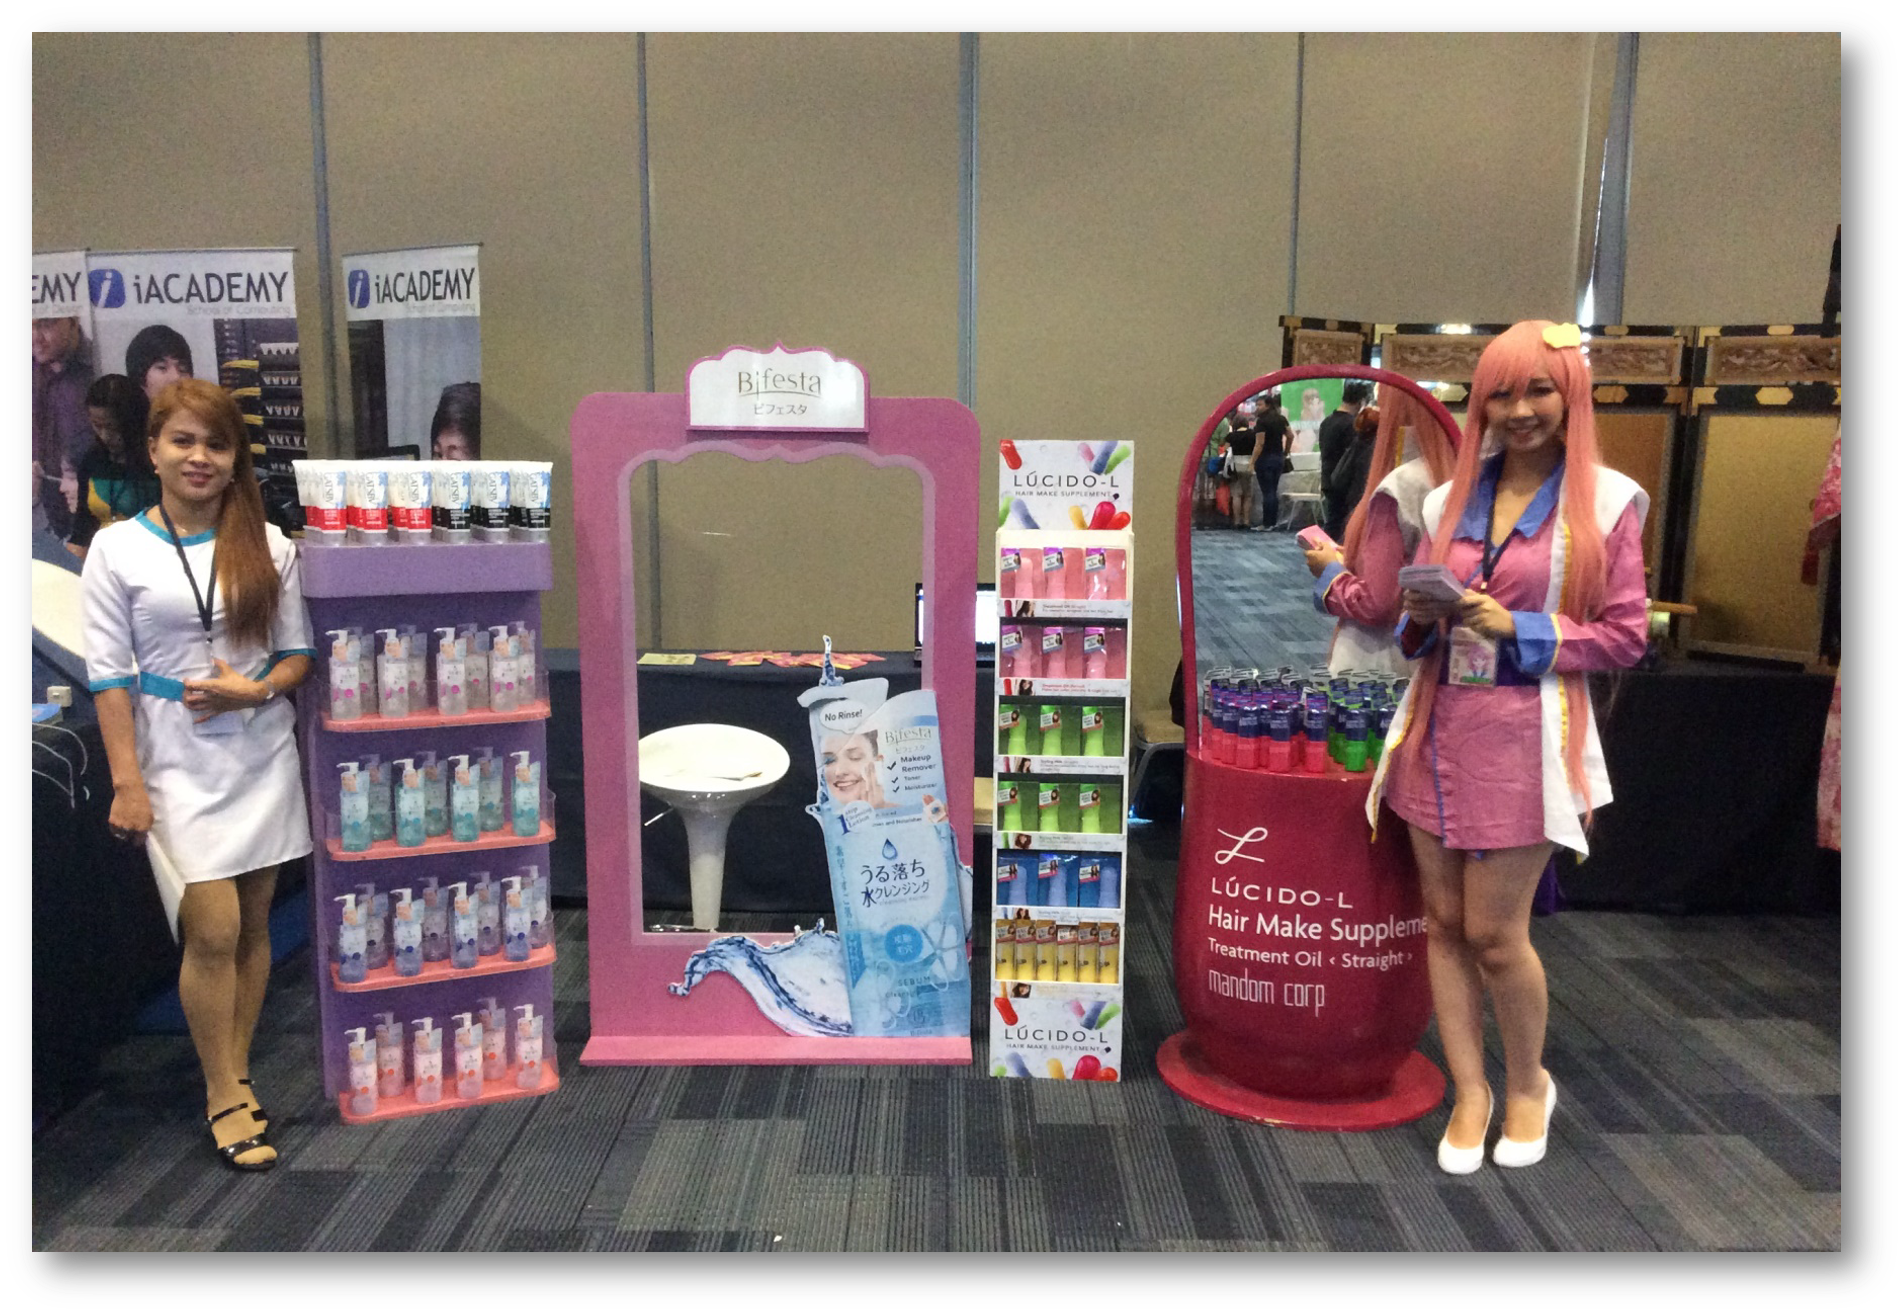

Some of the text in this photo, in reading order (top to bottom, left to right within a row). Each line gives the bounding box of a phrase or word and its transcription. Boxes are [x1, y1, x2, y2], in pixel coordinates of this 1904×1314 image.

[133, 272, 289, 304] iACADEMY
[375, 267, 475, 304] iACADEMY
[737, 368, 822, 399] Bifesta
[1013, 471, 1119, 488] LÚCIDO-L
[1061, 490, 1112, 498] SUPPLEMENT
[824, 709, 863, 722] No Rinse!
[885, 728, 932, 745] Bifesta
[900, 754, 932, 763] Makeup
[901, 764, 937, 773] Remover
[860, 858, 926, 885] うる落ち
[861, 879, 931, 908] 水クレンジング
[1211, 875, 1353, 909] LÚCIDO-L
[1208, 904, 1250, 933] Hair
[1256, 913, 1322, 940] Make
[1207, 937, 1289, 966] Treatment
[1295, 951, 1322, 968] Oil
[1342, 949, 1404, 972] Straight
[1208, 967, 1325, 1017] mandom corp
[1004, 1025, 1109, 1045] LÚCIDO-L
